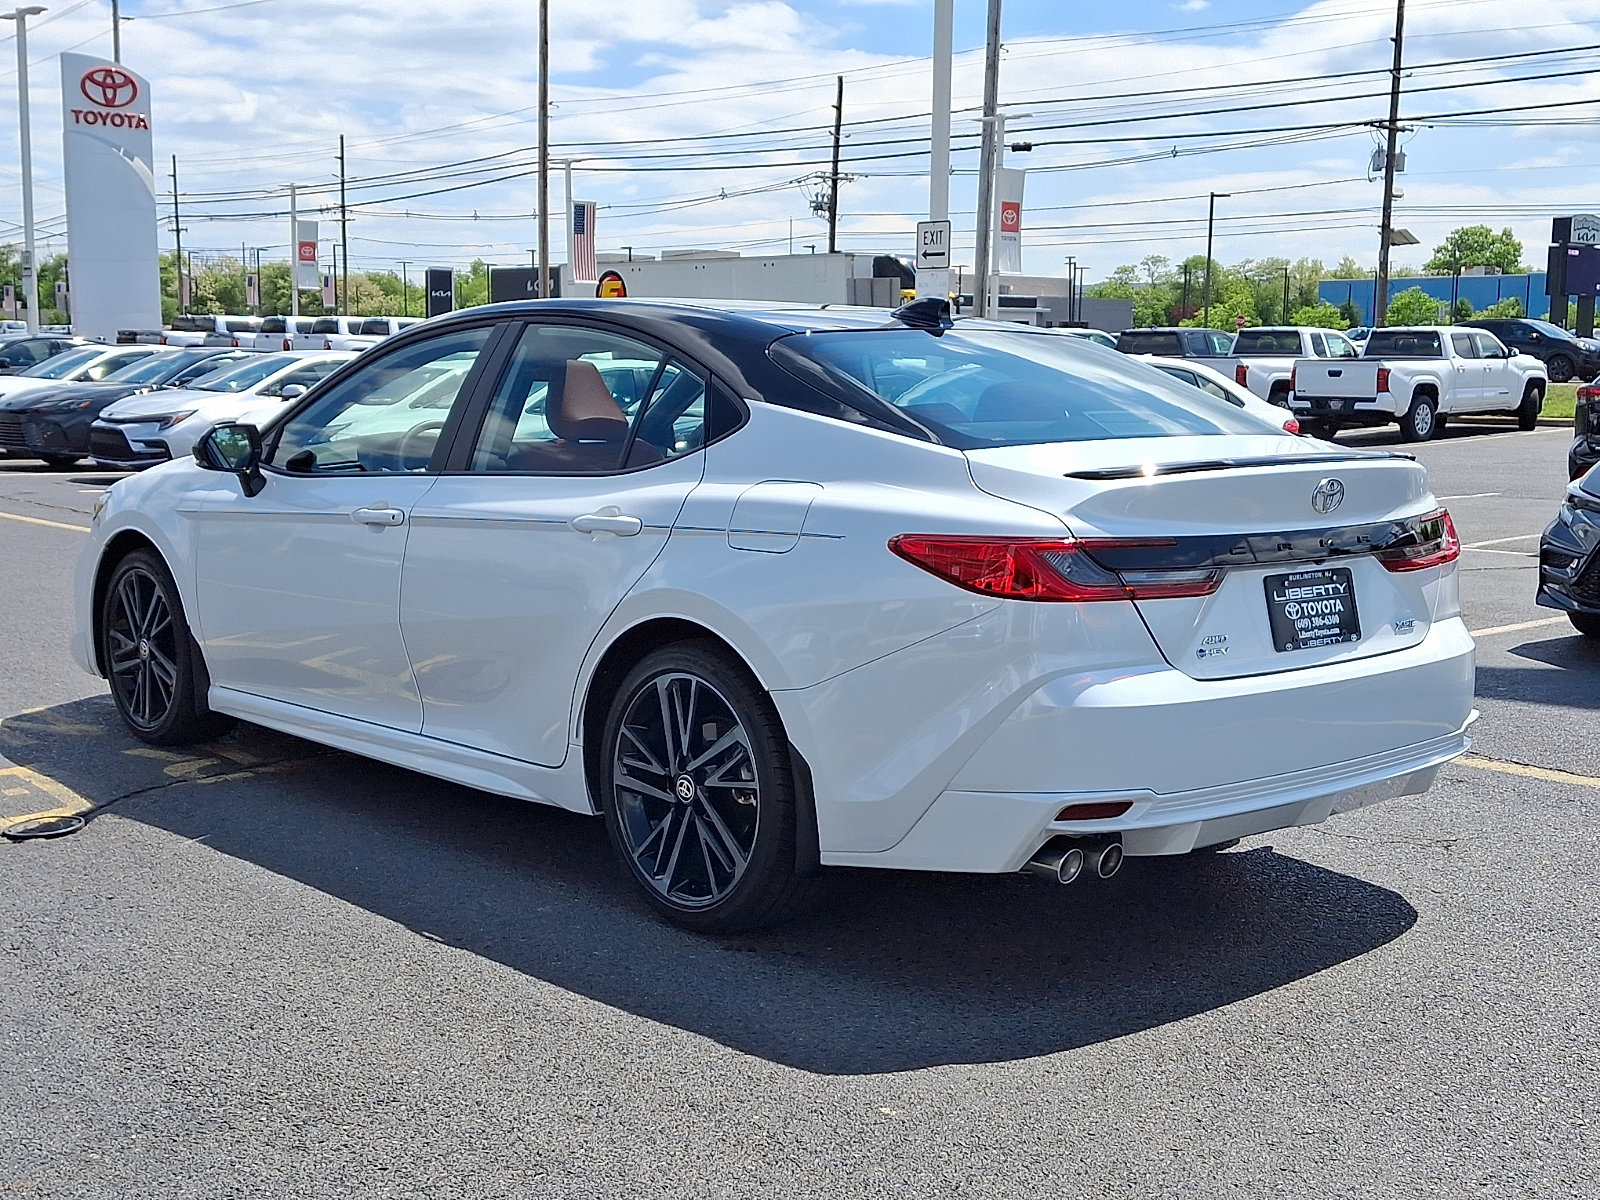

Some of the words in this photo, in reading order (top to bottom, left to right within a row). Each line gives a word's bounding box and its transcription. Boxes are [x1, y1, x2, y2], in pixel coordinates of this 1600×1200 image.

[71, 109, 149, 130] TOYOTA
[923, 230, 944, 246] EXIT
[1273, 582, 1347, 601] LIBERTY
[1301, 599, 1344, 616] TOYOTA
[1300, 636, 1344, 648] LIBERTY
